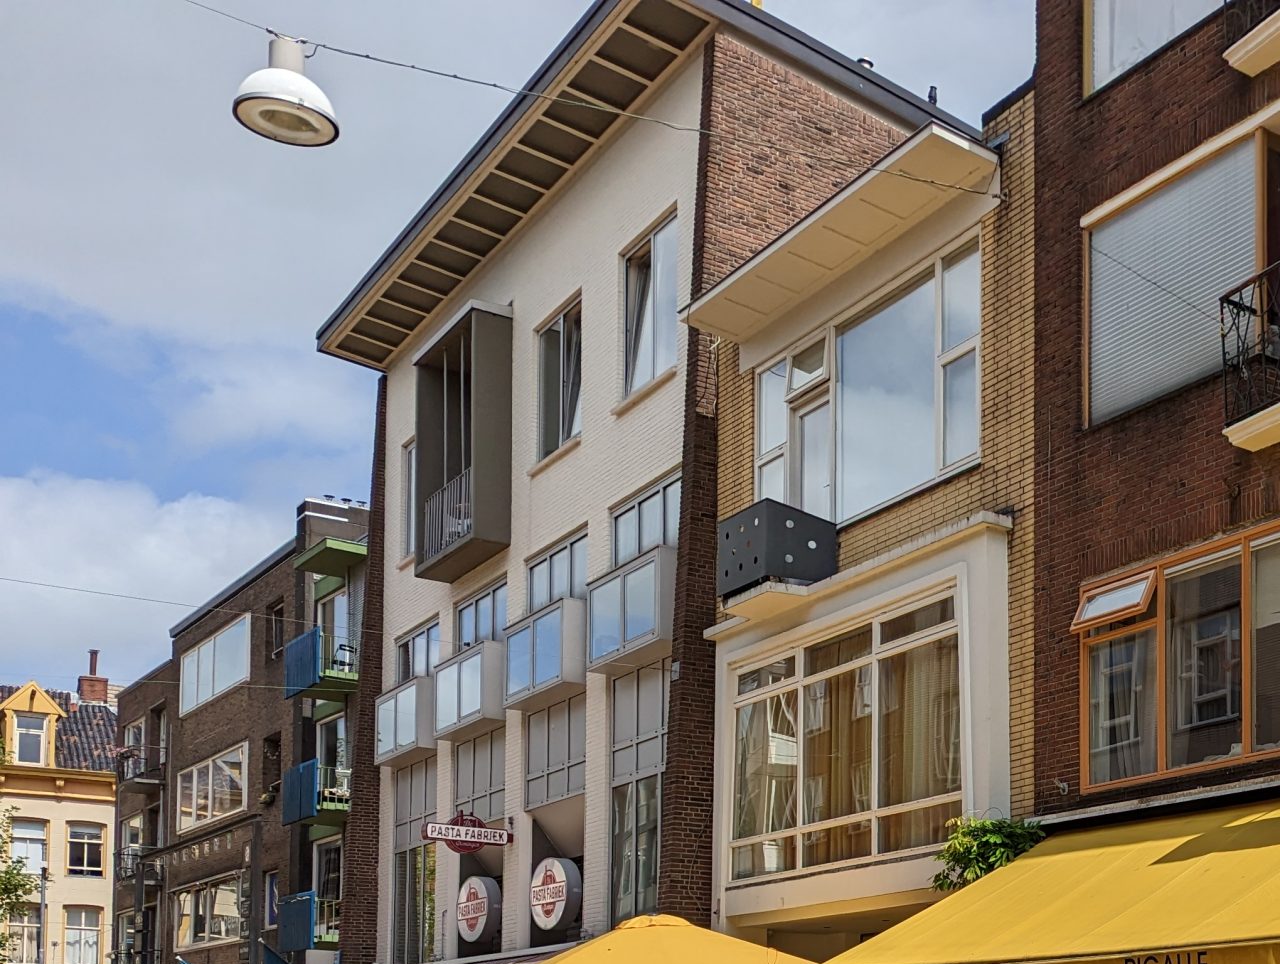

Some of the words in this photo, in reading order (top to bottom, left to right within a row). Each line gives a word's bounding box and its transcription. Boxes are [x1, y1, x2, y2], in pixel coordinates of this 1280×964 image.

[430, 825, 462, 839] PASTA
[464, 828, 505, 842] FABRIEK
[533, 888, 546, 903] PASTA
[547, 885, 564, 901] FABRIEK
[458, 905, 470, 918] PASTA
[471, 901, 485, 915] FABRIEK
